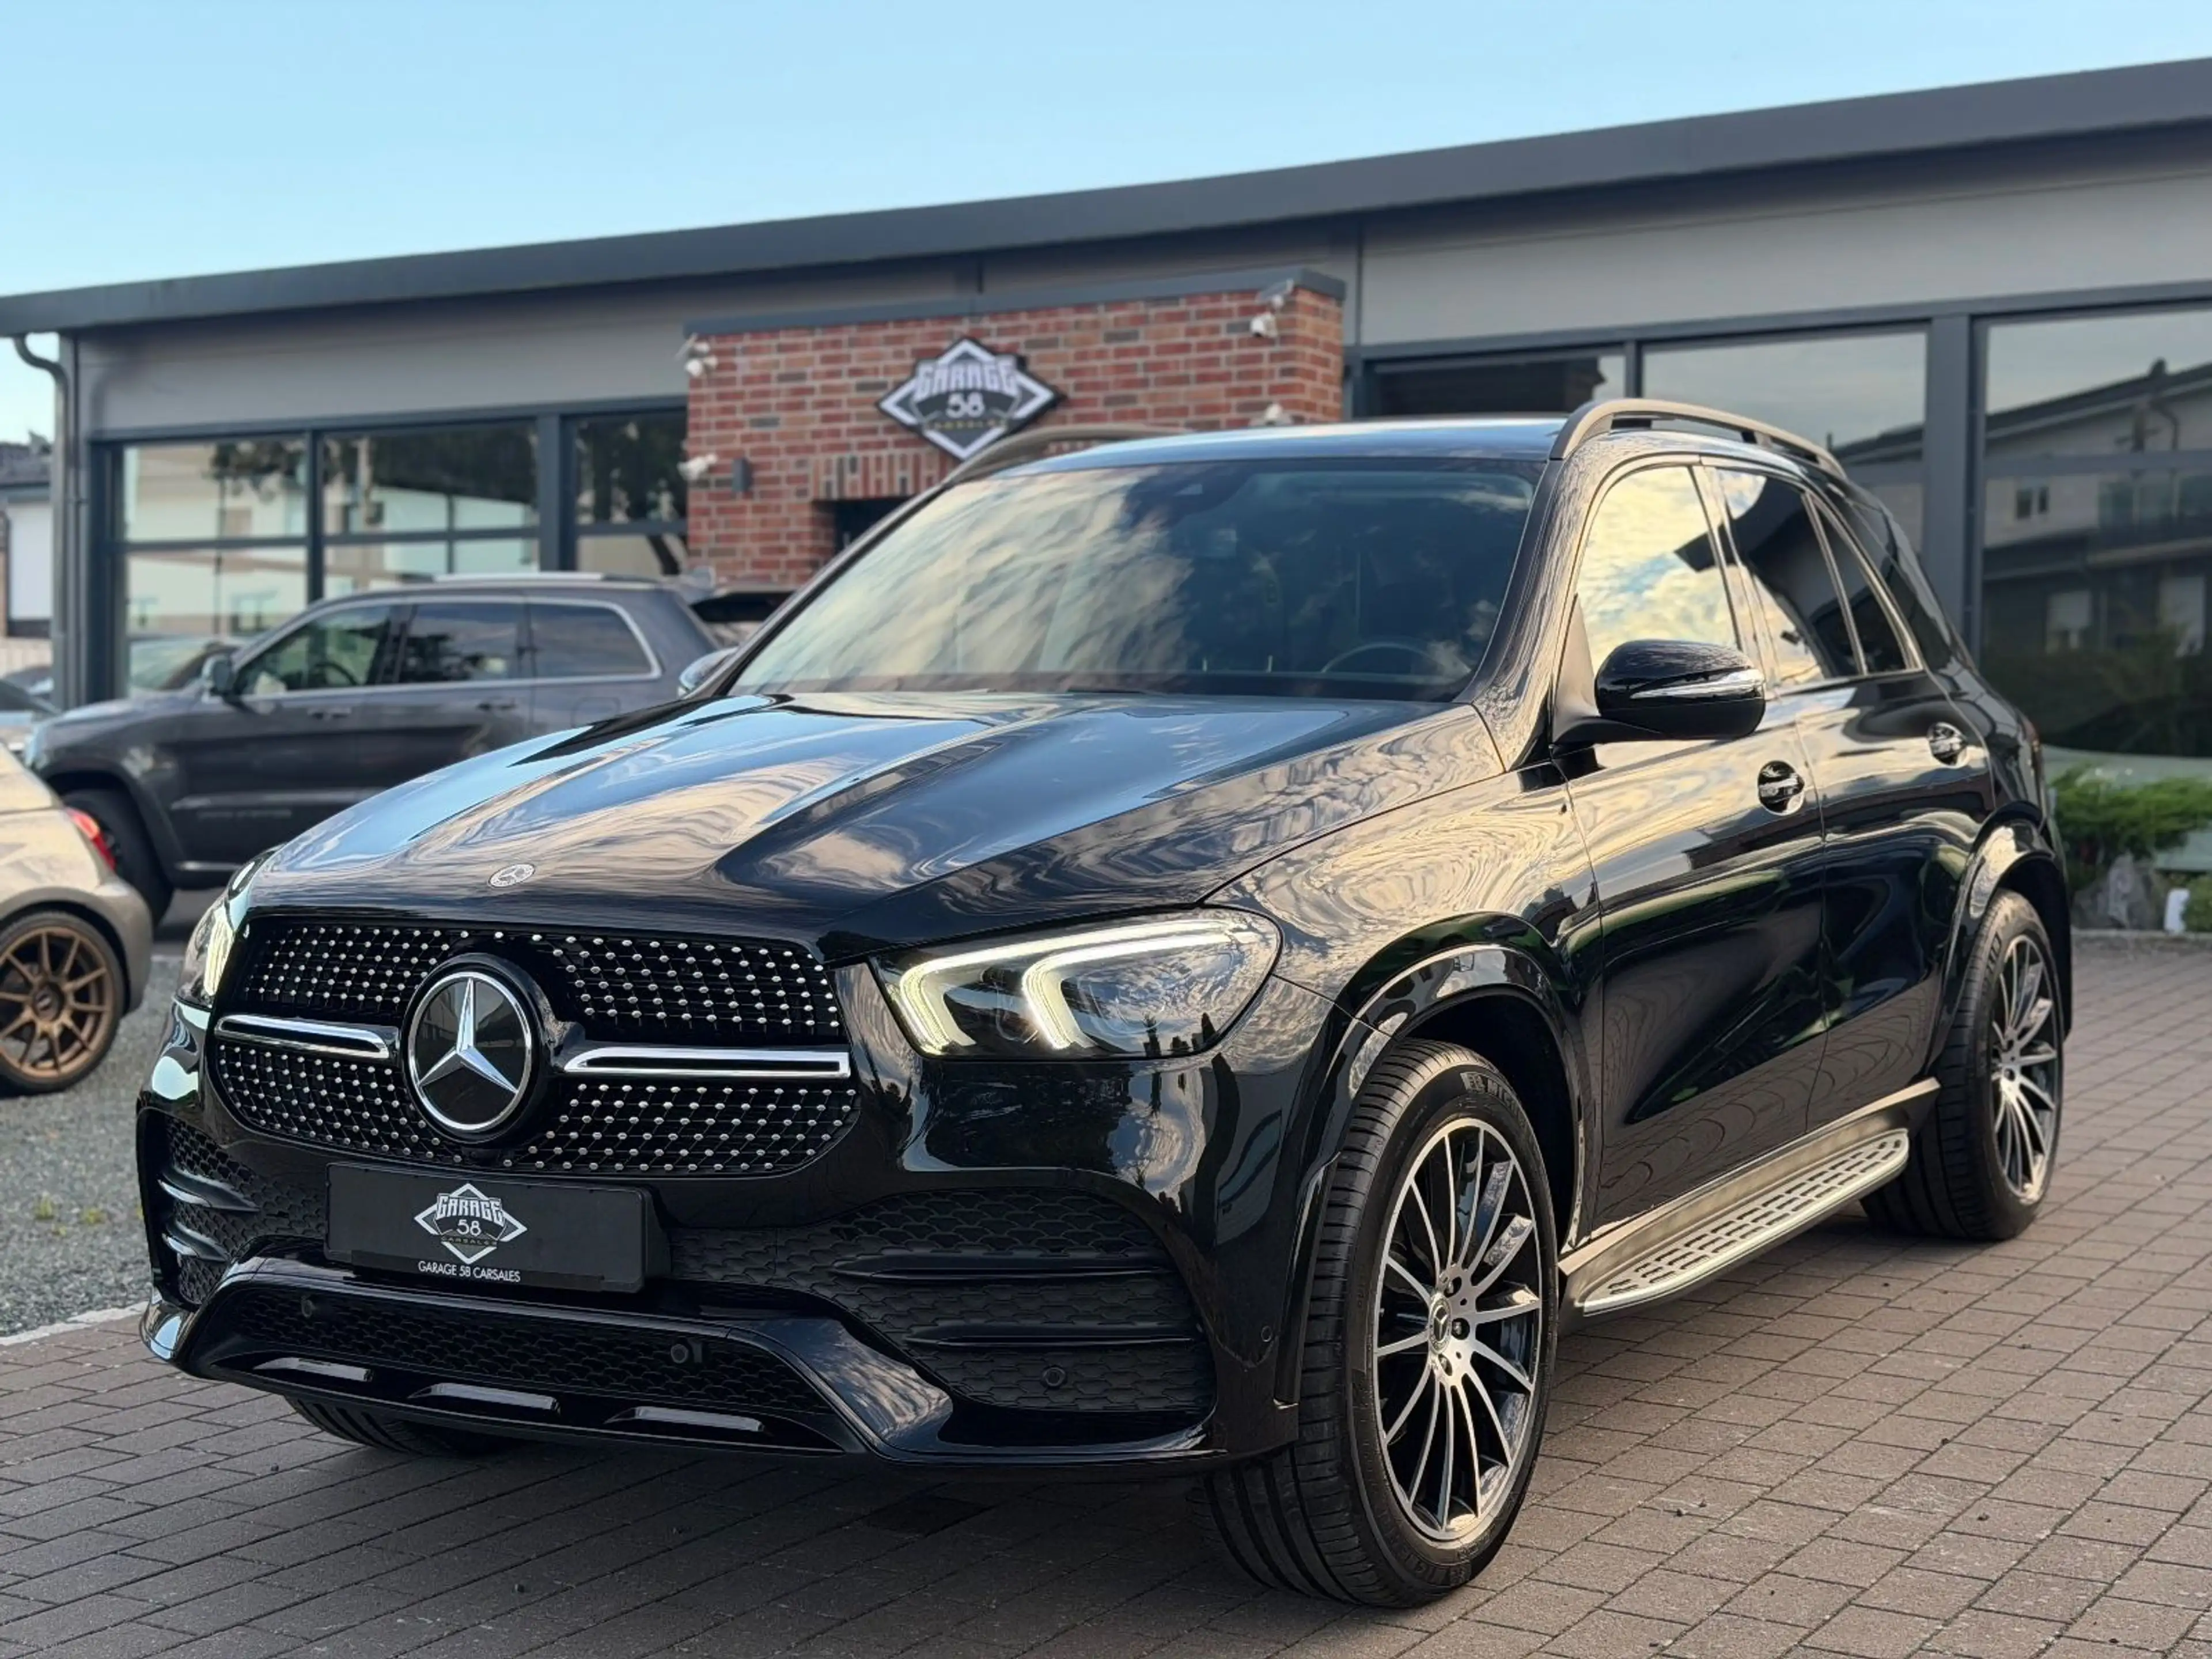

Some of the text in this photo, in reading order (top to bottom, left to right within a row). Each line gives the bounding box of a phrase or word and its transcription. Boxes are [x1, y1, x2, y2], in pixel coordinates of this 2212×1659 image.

[915, 359, 1017, 399] GARAGE
[946, 392, 984, 419] 58
[436, 1195, 504, 1227] GARAGE
[457, 1219, 482, 1236] 58
[418, 1260, 521, 1282] GARAGE 58 CARSALES
